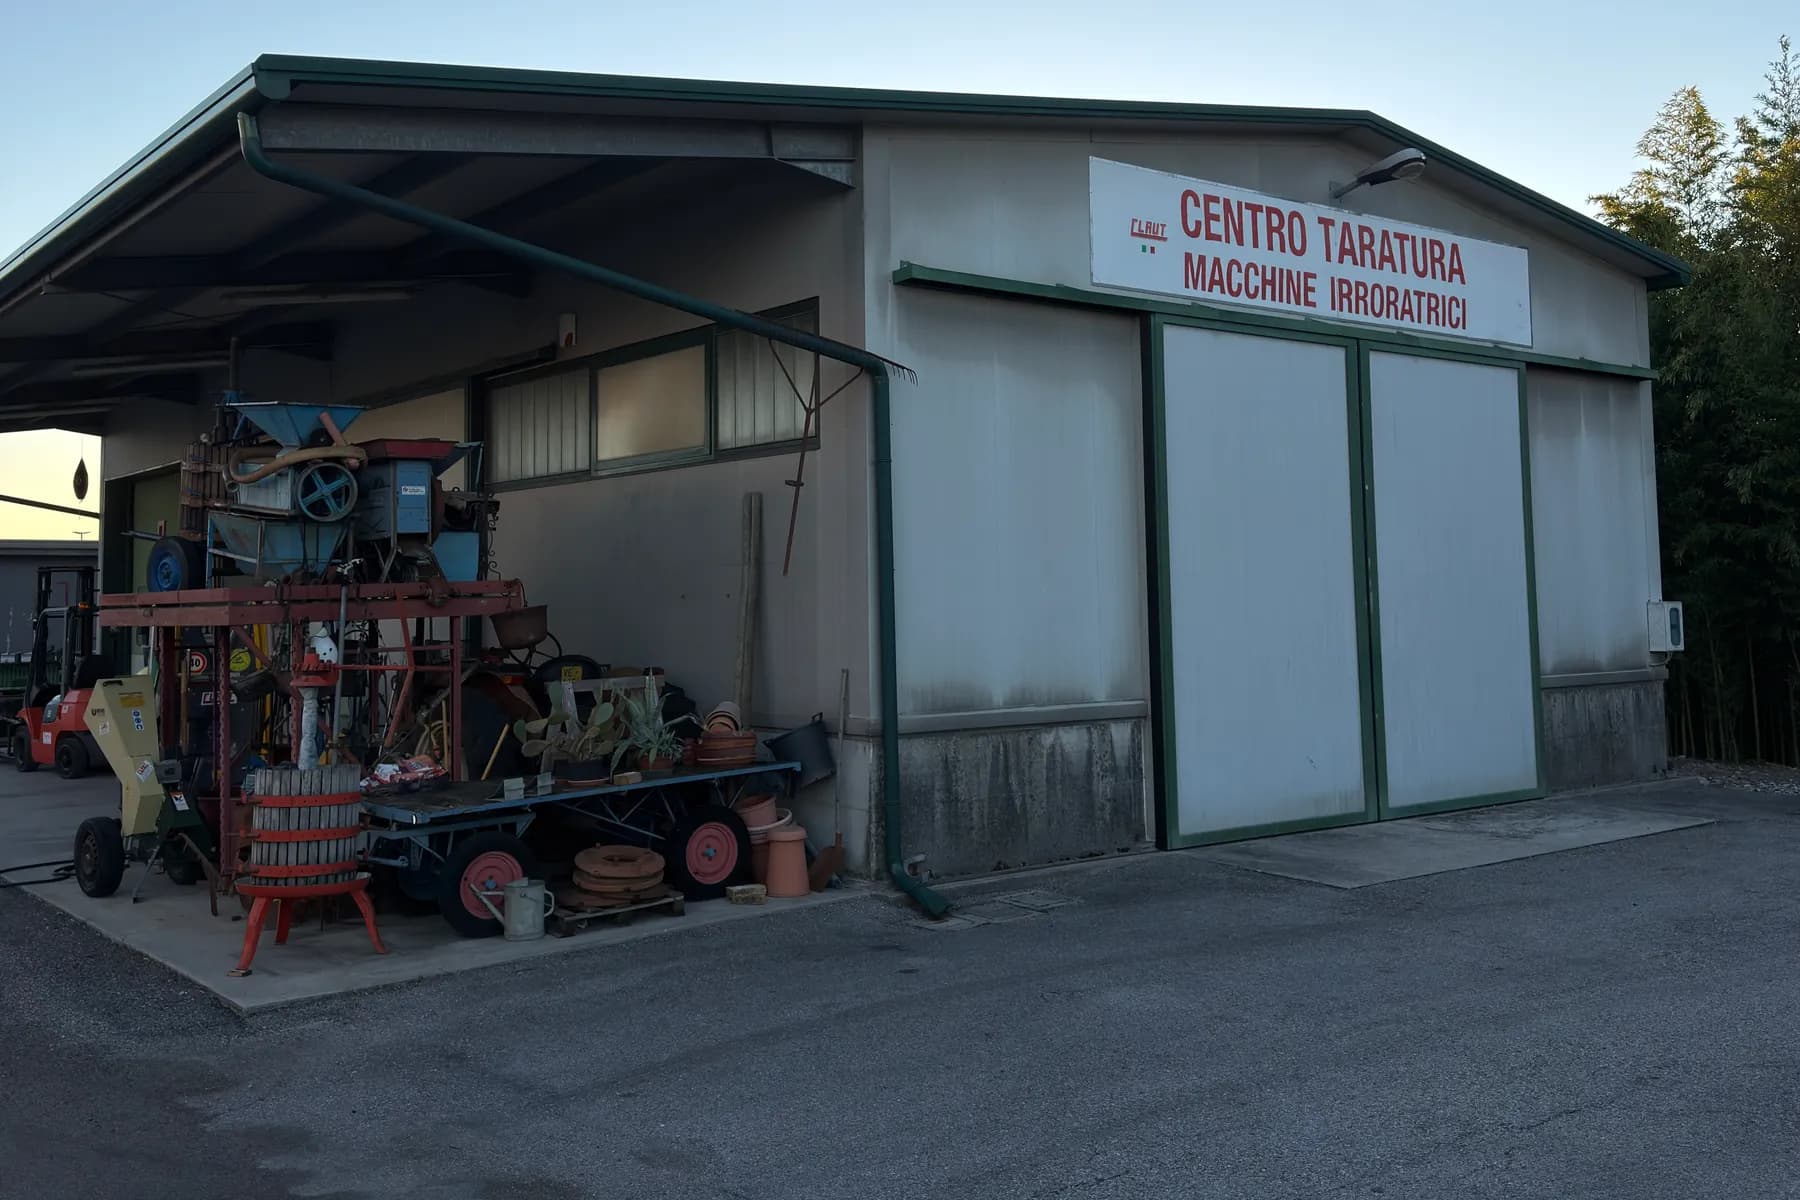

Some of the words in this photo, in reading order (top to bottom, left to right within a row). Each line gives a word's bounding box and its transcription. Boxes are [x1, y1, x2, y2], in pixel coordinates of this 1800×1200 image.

[1180, 189, 1307, 257] CENTRO
[1317, 216, 1466, 285] TARATURA
[1184, 252, 1316, 308] MACCHINE
[1330, 276, 1466, 330] IRRORATRICI
